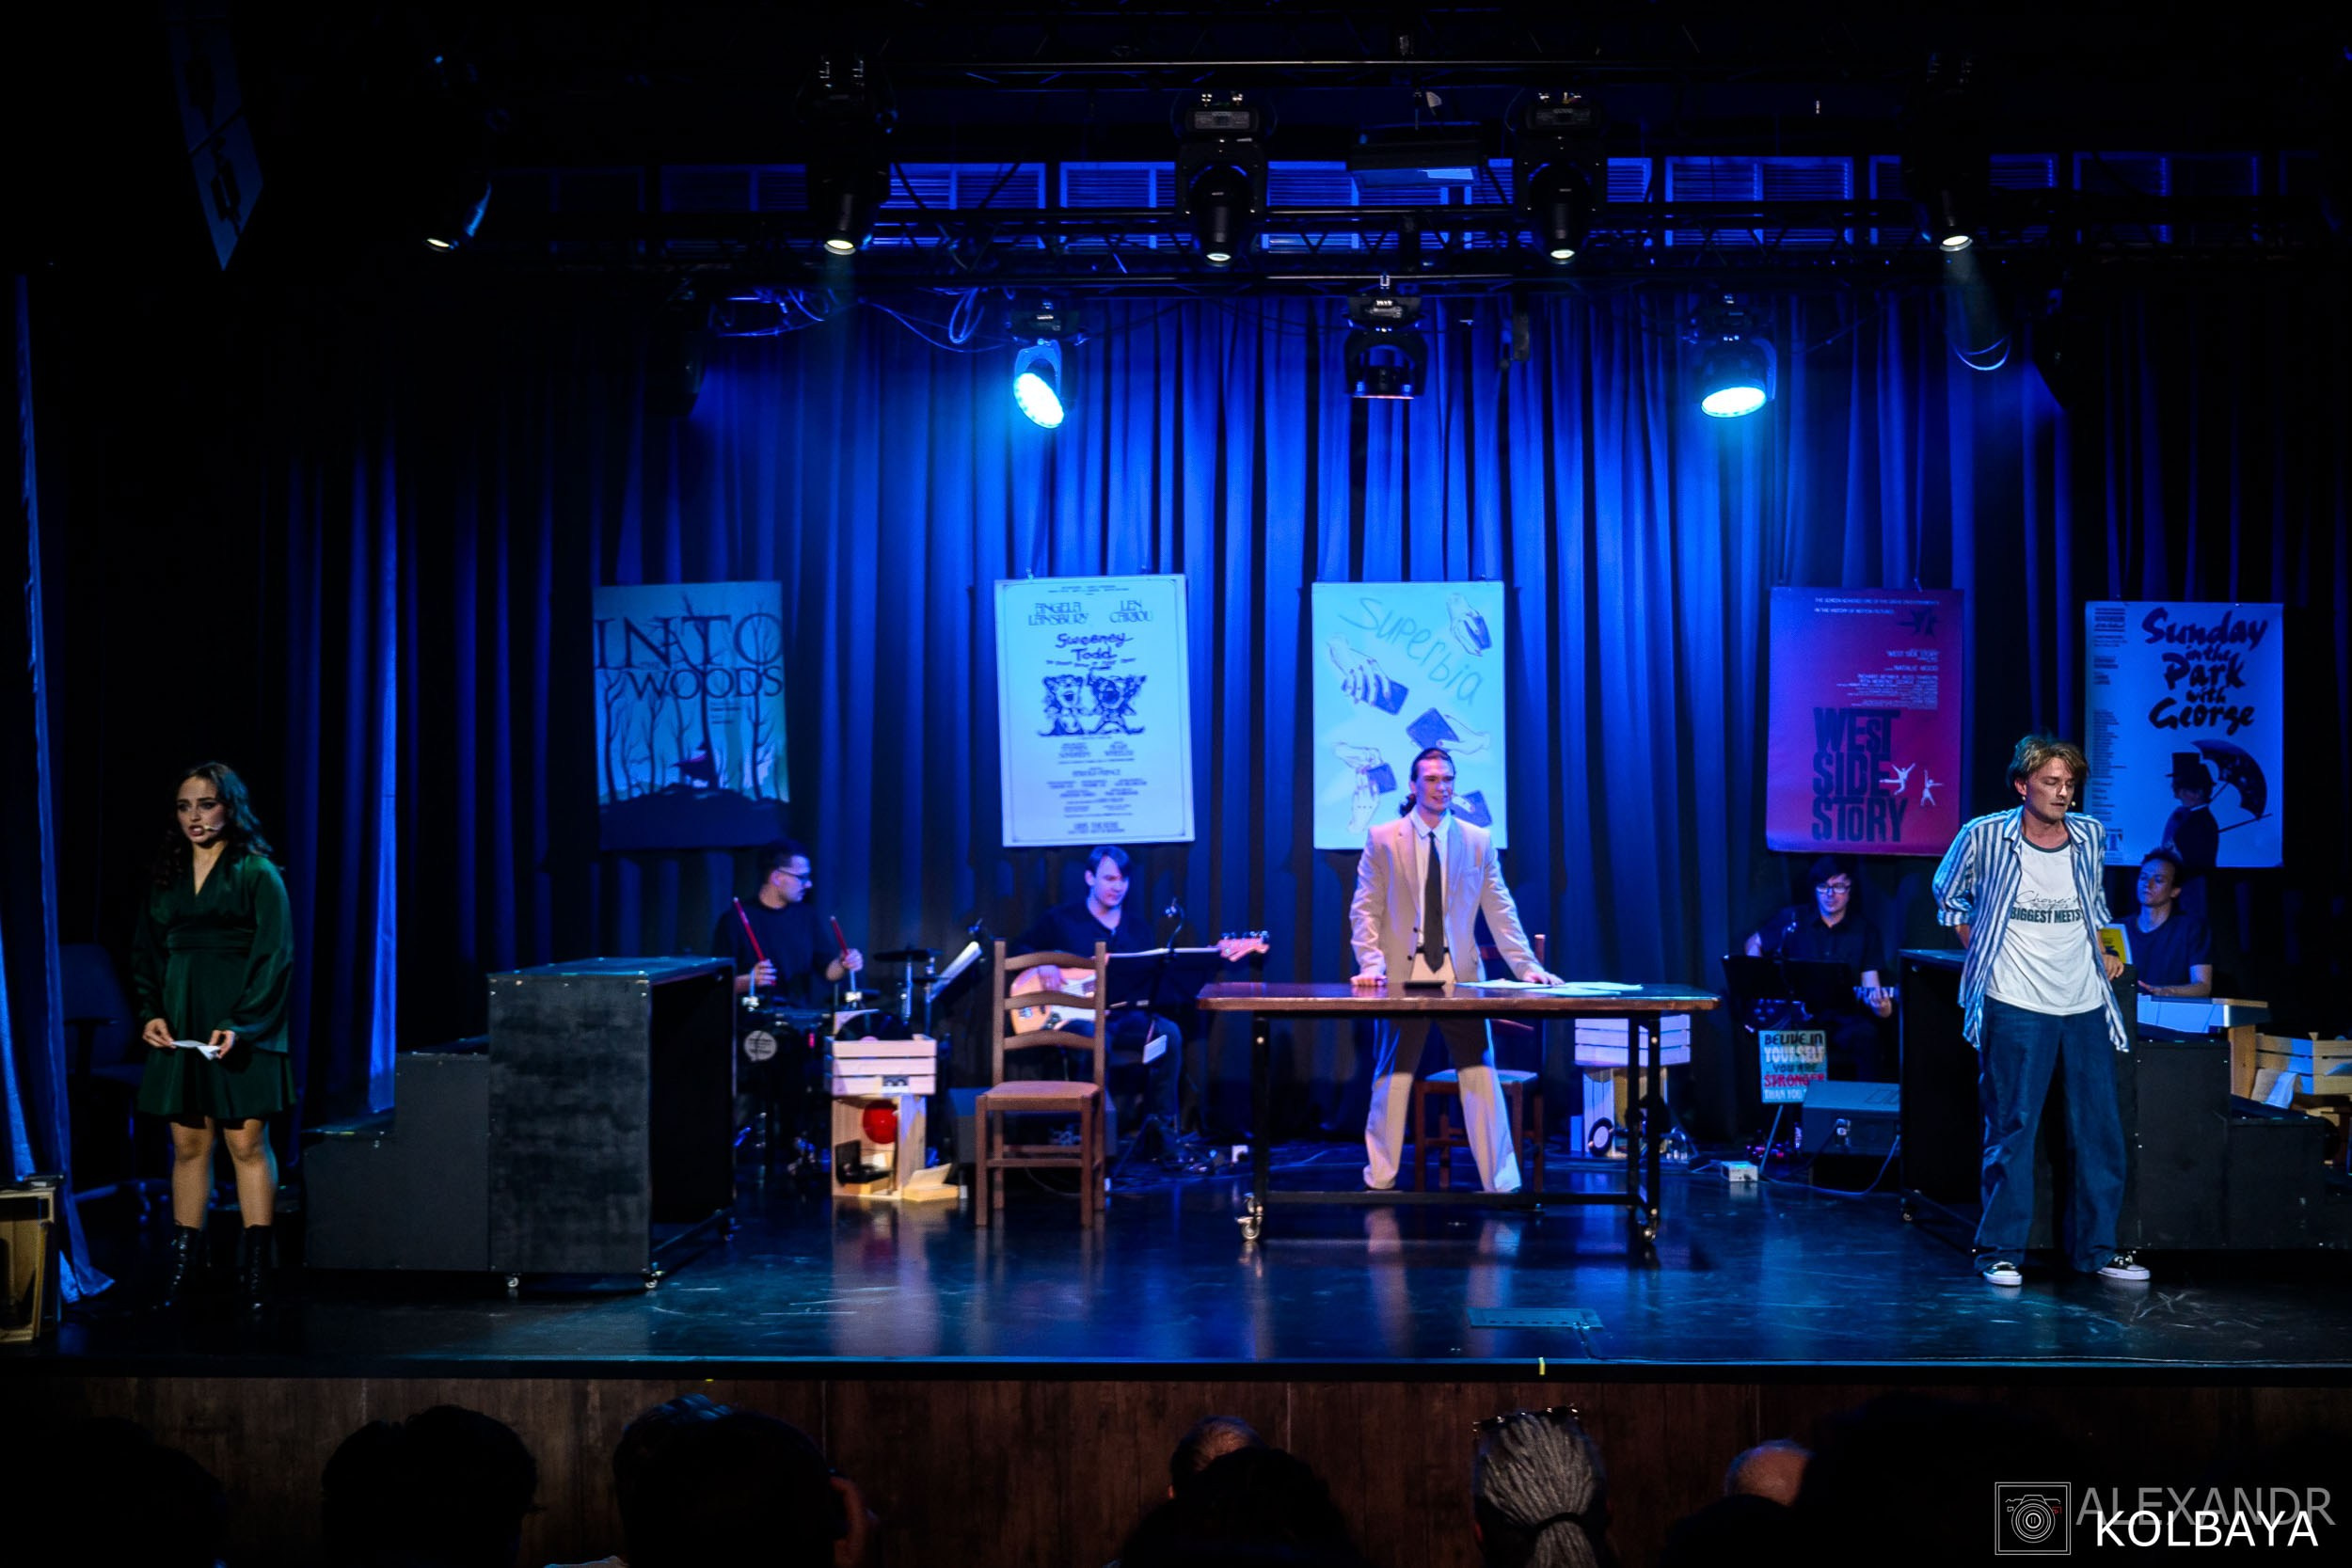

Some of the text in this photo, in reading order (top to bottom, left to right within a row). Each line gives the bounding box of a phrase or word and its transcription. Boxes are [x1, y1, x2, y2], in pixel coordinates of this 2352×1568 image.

[1120, 599, 1142, 611] LEN
[595, 613, 783, 669] INTO
[1055, 633, 1135, 648] Sweeney
[2141, 607, 2268, 652] Sunday
[1071, 646, 1118, 661] Todd
[2185, 644, 2231, 662] in the
[625, 666, 783, 700] WOODS
[2162, 652, 2246, 690] Park
[2185, 686, 2226, 704] with
[1813, 707, 1900, 752] WEST
[2148, 697, 2255, 736] George
[1813, 752, 1890, 797] SIDE
[1812, 797, 1908, 843] STORY
[2010, 907, 2052, 923] BIGGEST
[1764, 1045, 1824, 1063] YOURSELF
